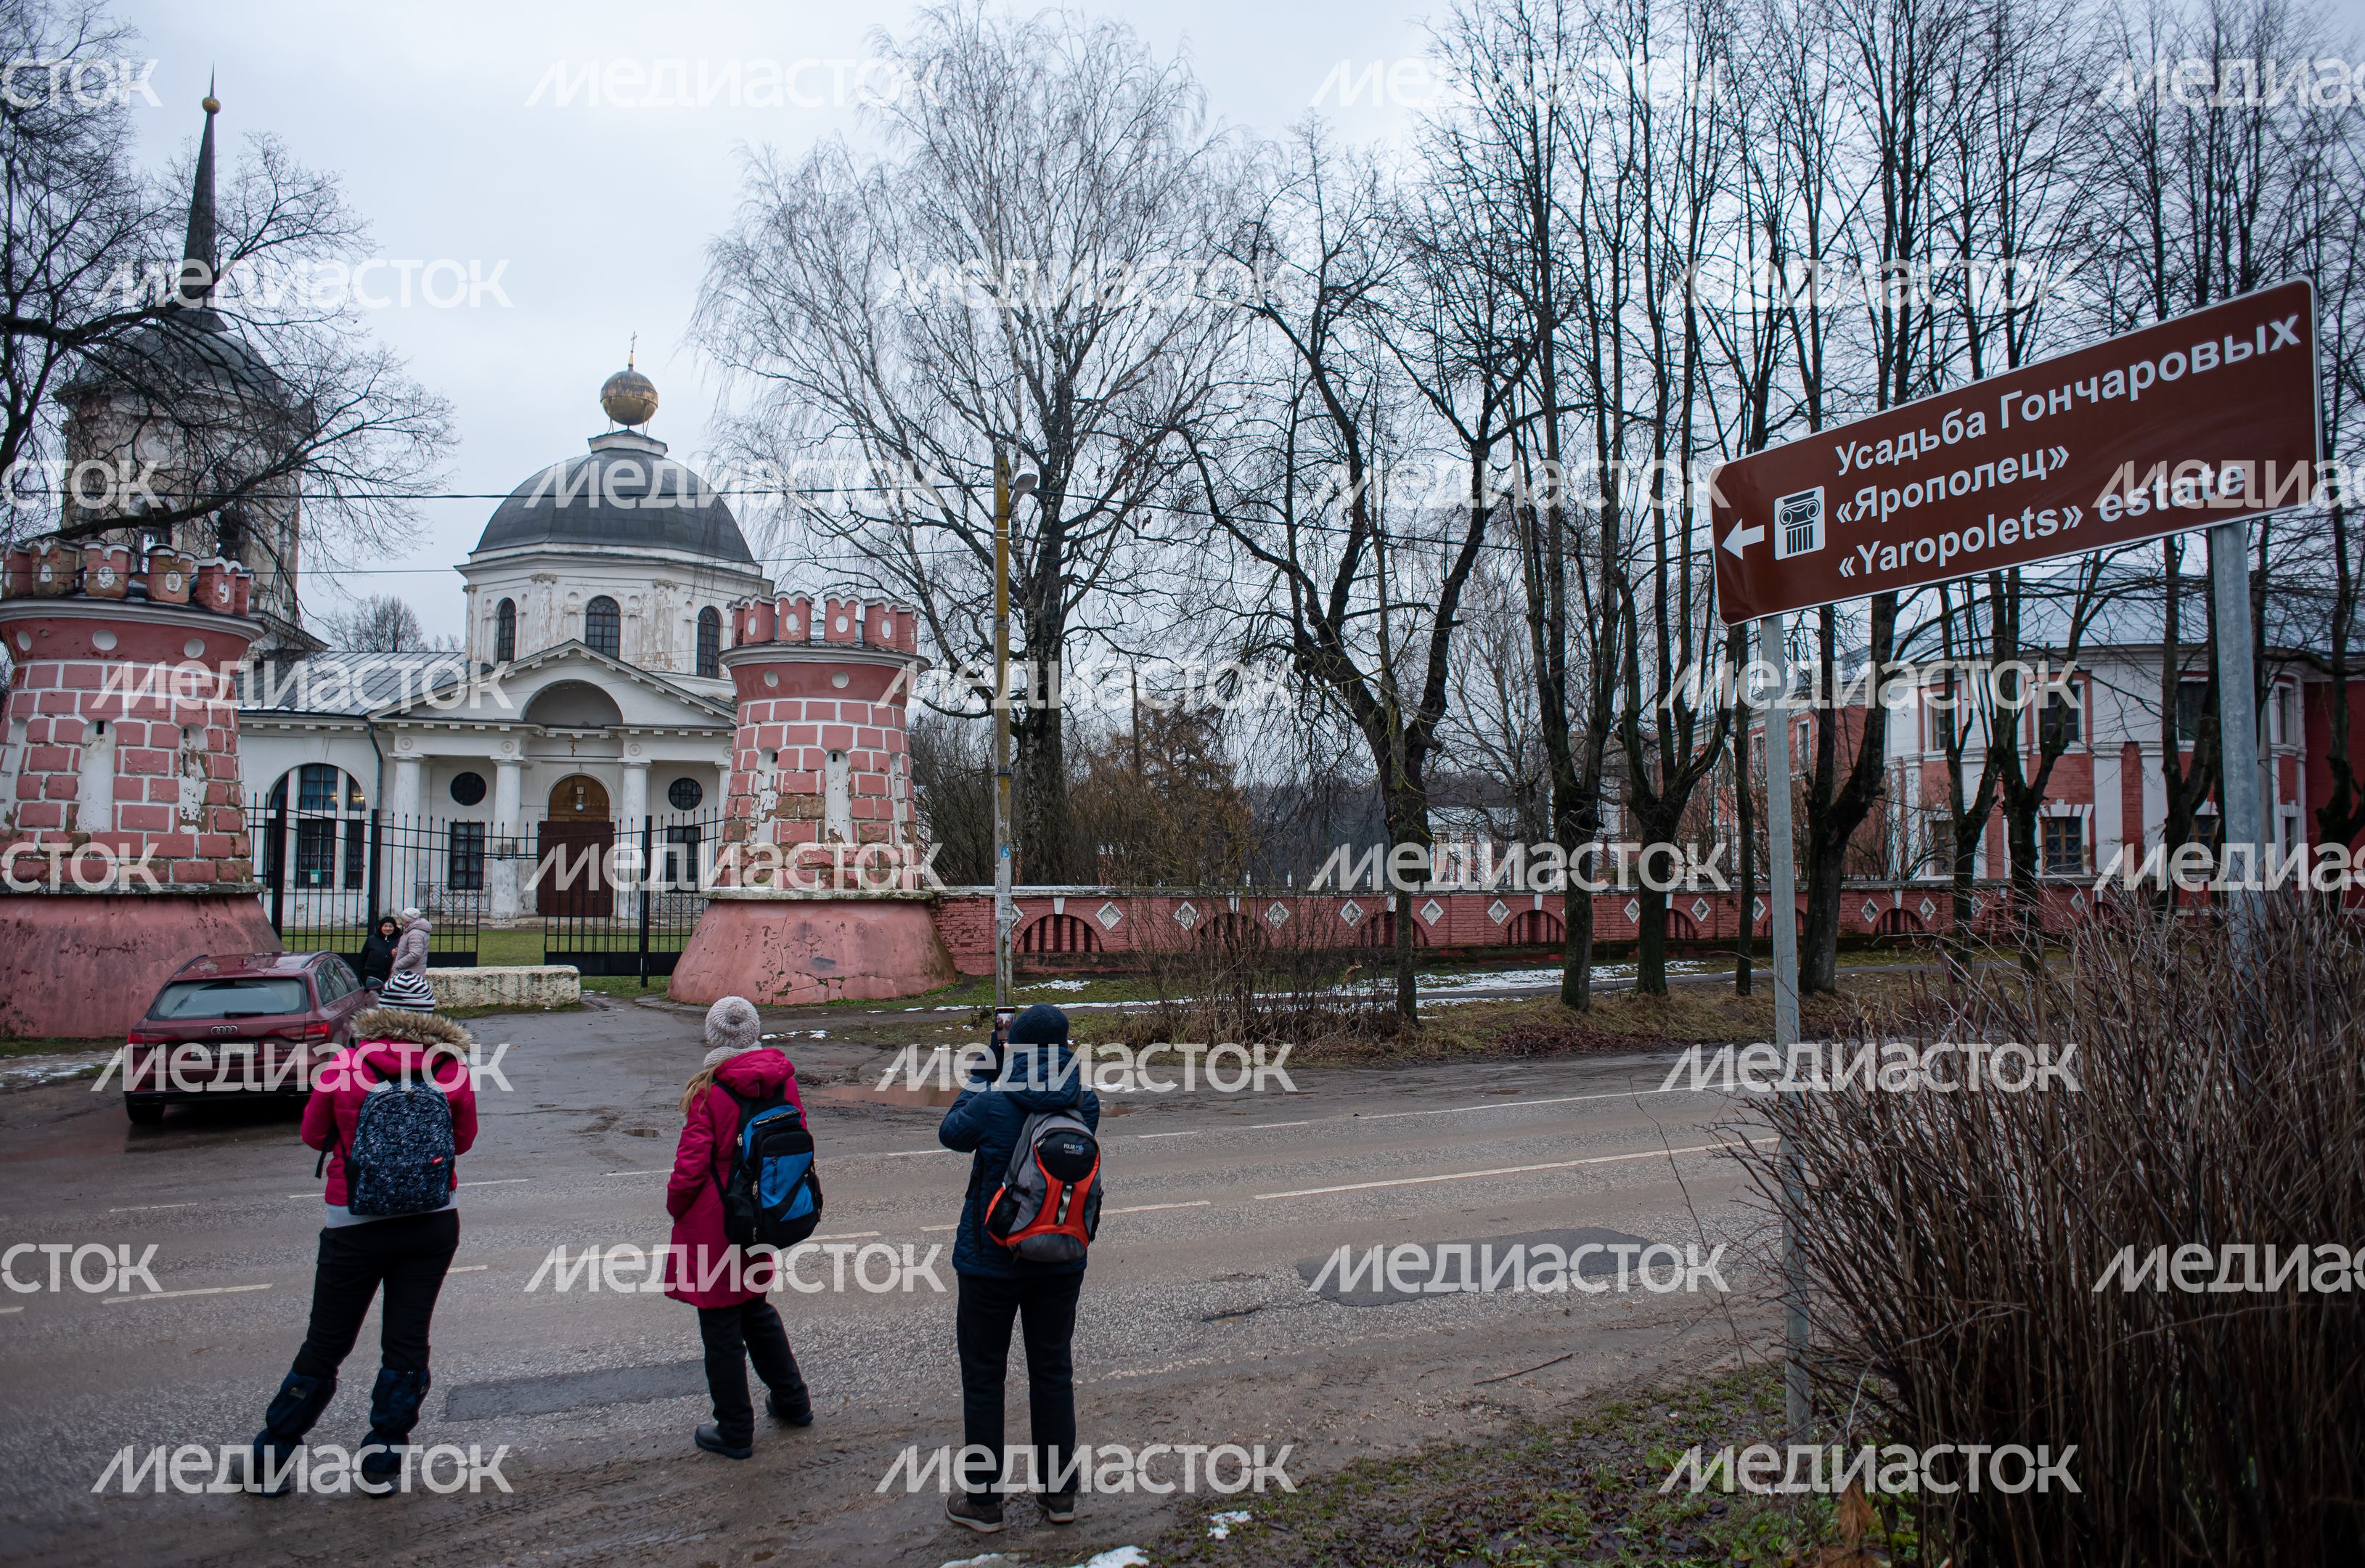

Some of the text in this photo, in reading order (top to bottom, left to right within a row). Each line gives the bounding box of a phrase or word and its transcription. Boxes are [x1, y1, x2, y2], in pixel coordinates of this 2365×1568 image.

[1835, 314, 2301, 475] Усадьба Гончаровых
[1836, 445, 2070, 523] «Ярополец»
[1838, 463, 2245, 578] «Yaropolets» estate
